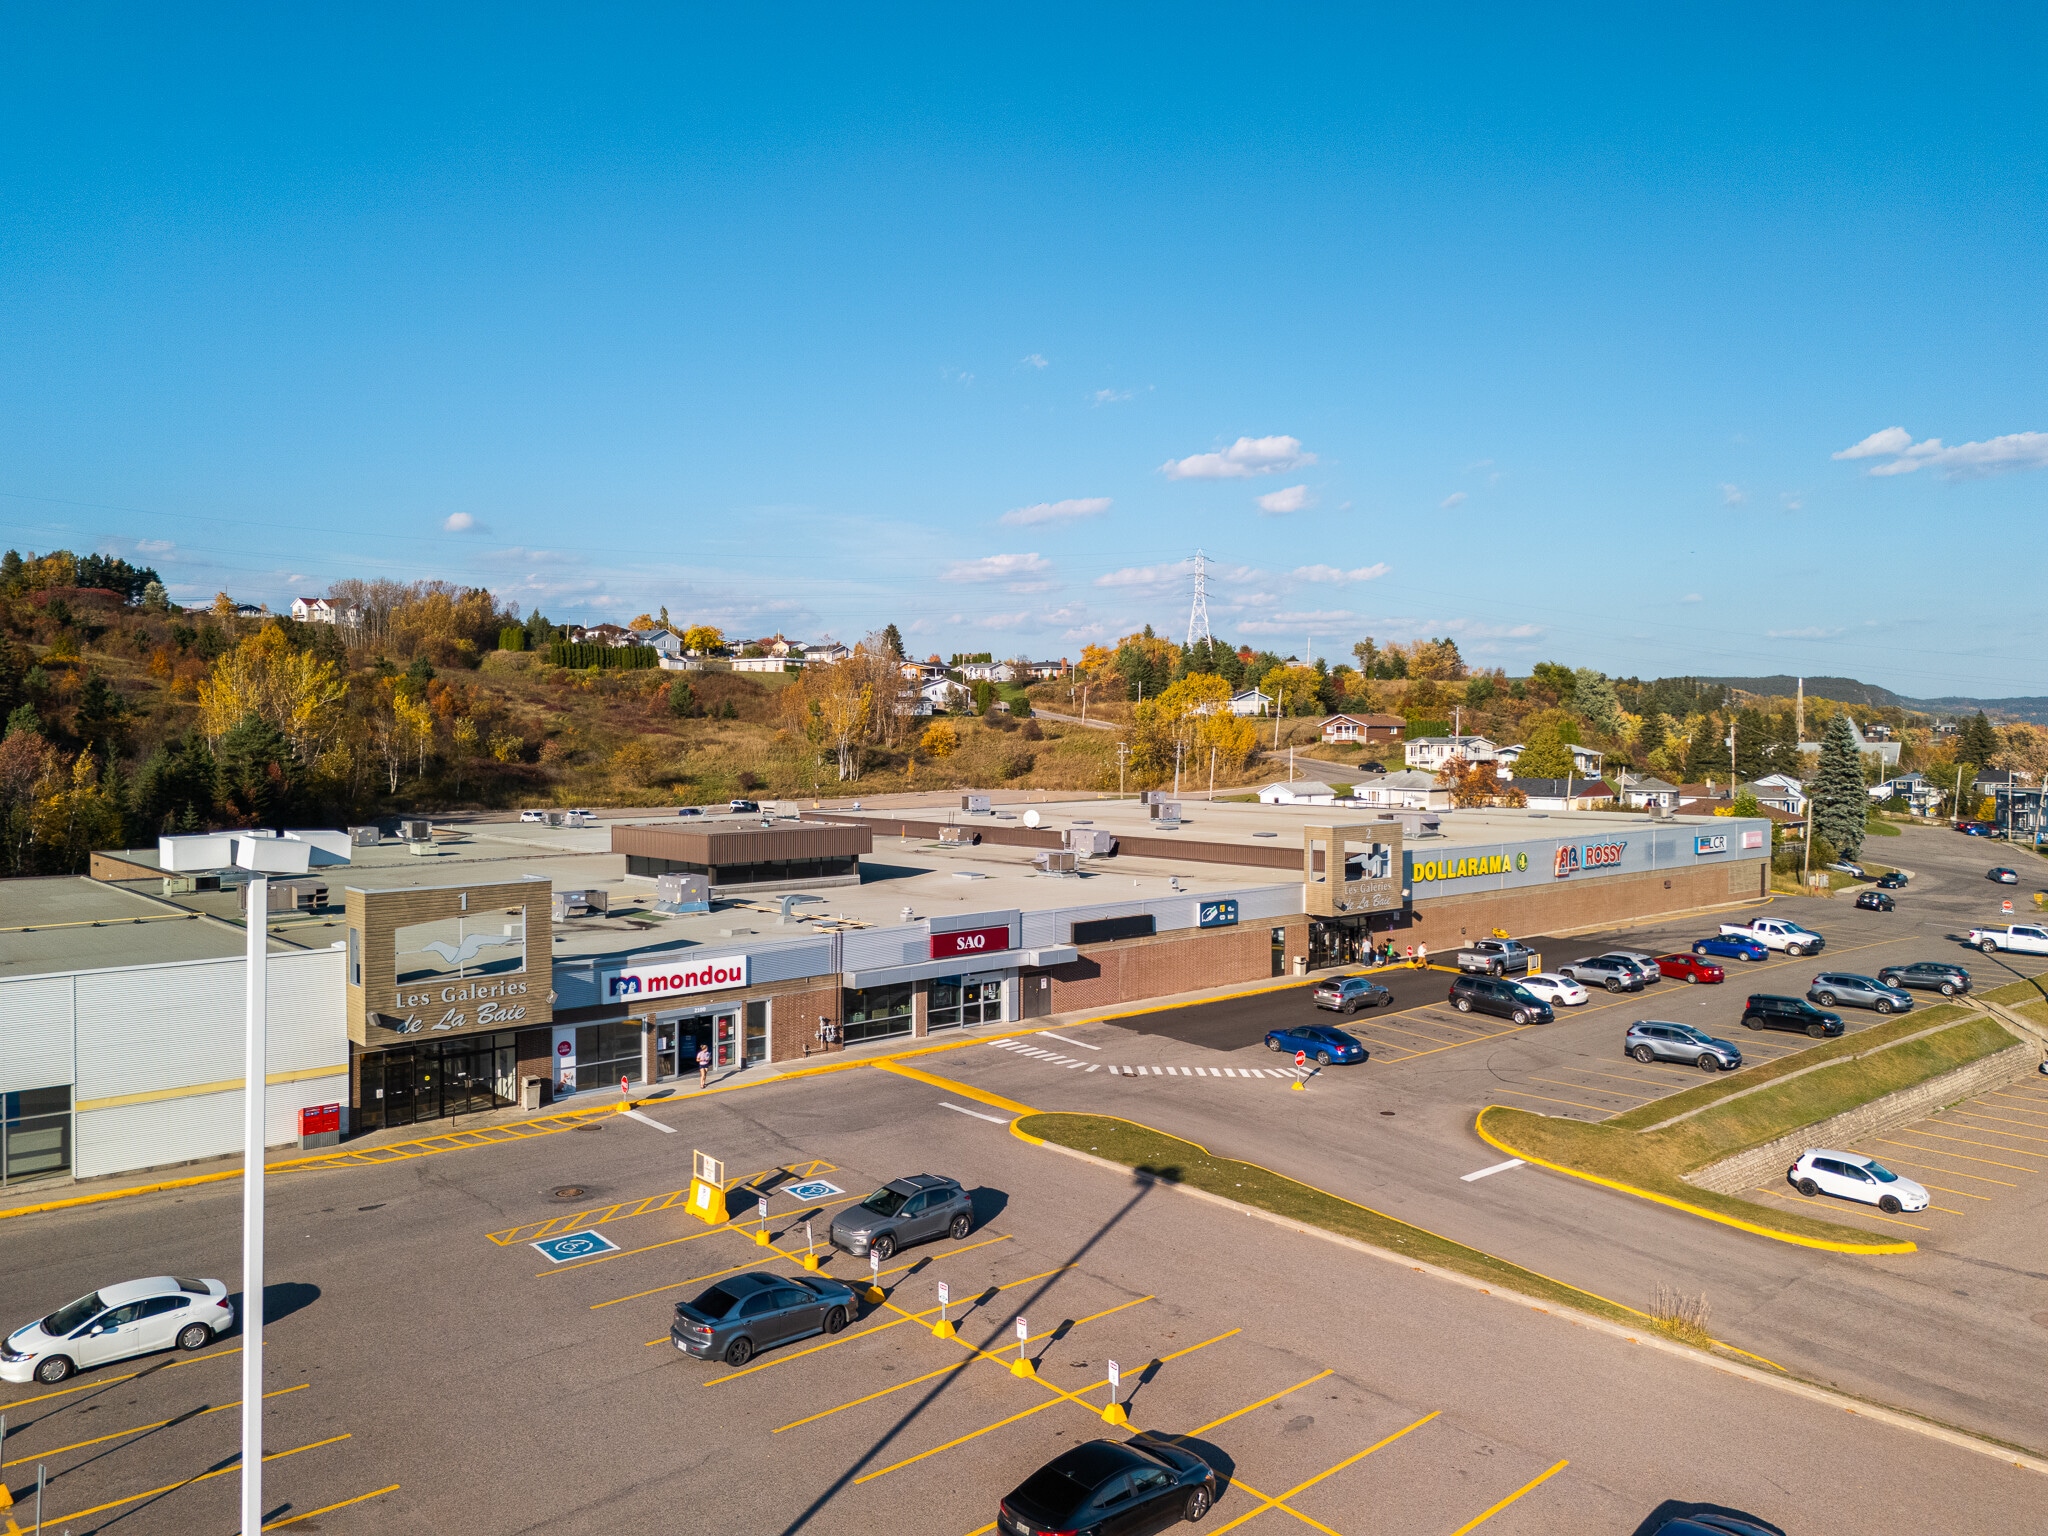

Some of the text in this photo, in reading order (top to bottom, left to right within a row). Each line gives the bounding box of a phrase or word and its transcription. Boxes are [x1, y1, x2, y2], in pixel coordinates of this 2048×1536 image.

[1365, 828, 1372, 839] 2
[1708, 836, 1725, 849] LCR
[1585, 841, 1626, 867] ROSSY
[1412, 854, 1512, 883] DOLLARAMA
[1344, 881, 1392, 895] Les Galeries
[457, 892, 468, 911] 1
[1357, 896, 1369, 910] La
[1372, 893, 1392, 907] Baie
[956, 934, 985, 950] SAQ
[648, 965, 741, 993] mondou
[396, 980, 527, 1009] Les Galeries
[396, 1001, 527, 1034] de La Baie
